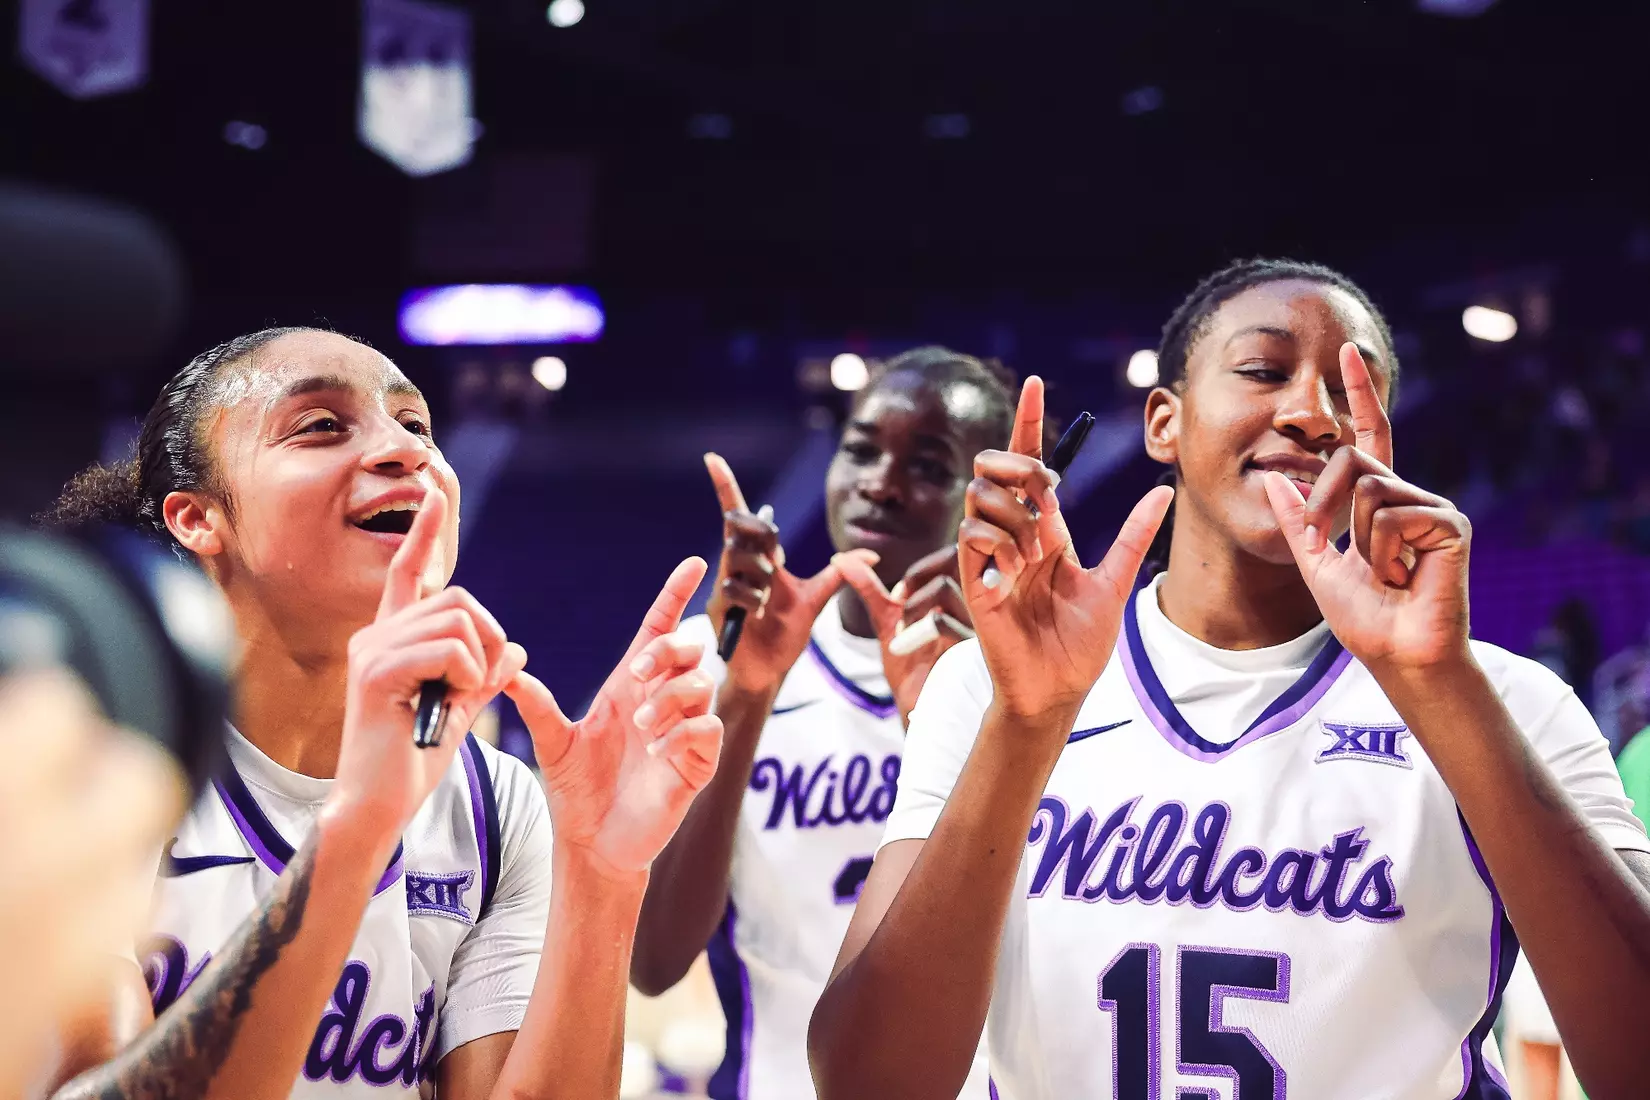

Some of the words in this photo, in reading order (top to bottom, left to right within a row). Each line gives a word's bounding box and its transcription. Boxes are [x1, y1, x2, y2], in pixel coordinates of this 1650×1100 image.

[1318, 721, 1409, 765] XII
[1027, 794, 1405, 923] Wildcats
[1097, 942, 1291, 1100] 15
